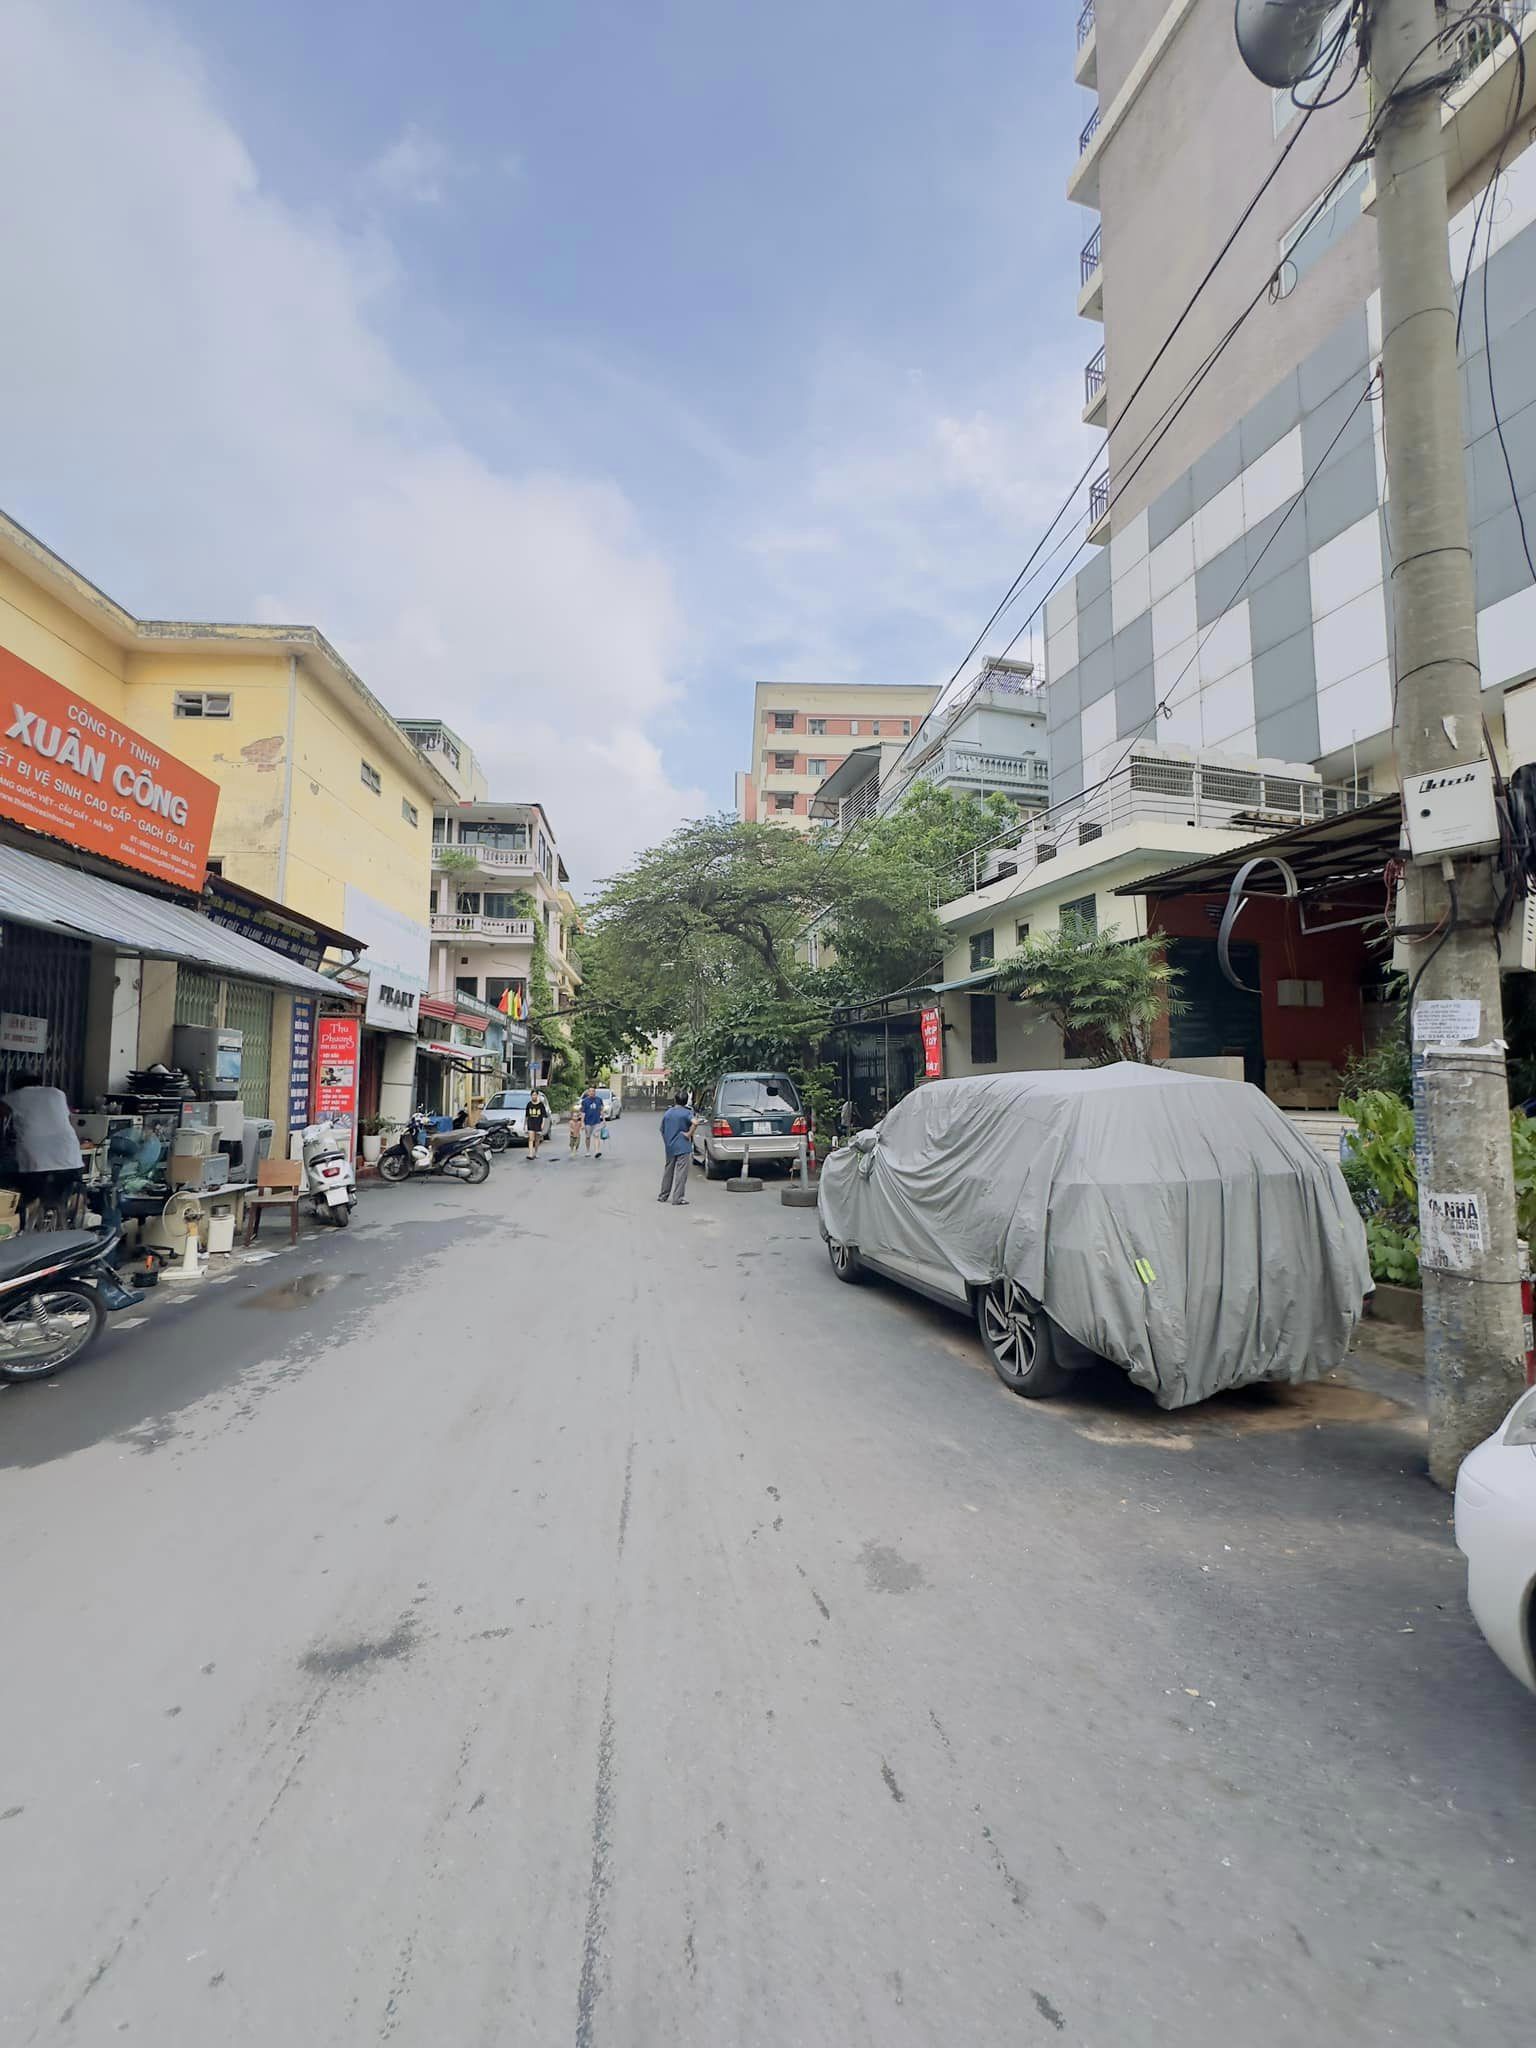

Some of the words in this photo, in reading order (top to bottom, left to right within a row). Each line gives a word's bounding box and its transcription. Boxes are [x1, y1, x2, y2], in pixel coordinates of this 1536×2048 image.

[4, 703, 106, 783] XUÂN
[112, 764, 189, 827] CÔNG
[68, 705, 107, 738] CÔNG
[109, 729, 126, 748] TY
[129, 742, 161, 769] TNHH
[17, 760, 31, 780] BỊ
[34, 767, 51, 787] VỆ
[54, 778, 82, 801] SINH
[84, 793, 108, 813] CAO
[110, 806, 132, 823] CẤP
[138, 819, 164, 840] GẠCH
[165, 830, 178, 845] ỐP
[179, 839, 195, 854] LÁT
[330, 1022, 349, 1034] Thu
[1444, 1199, 1478, 1219] NHÀ
